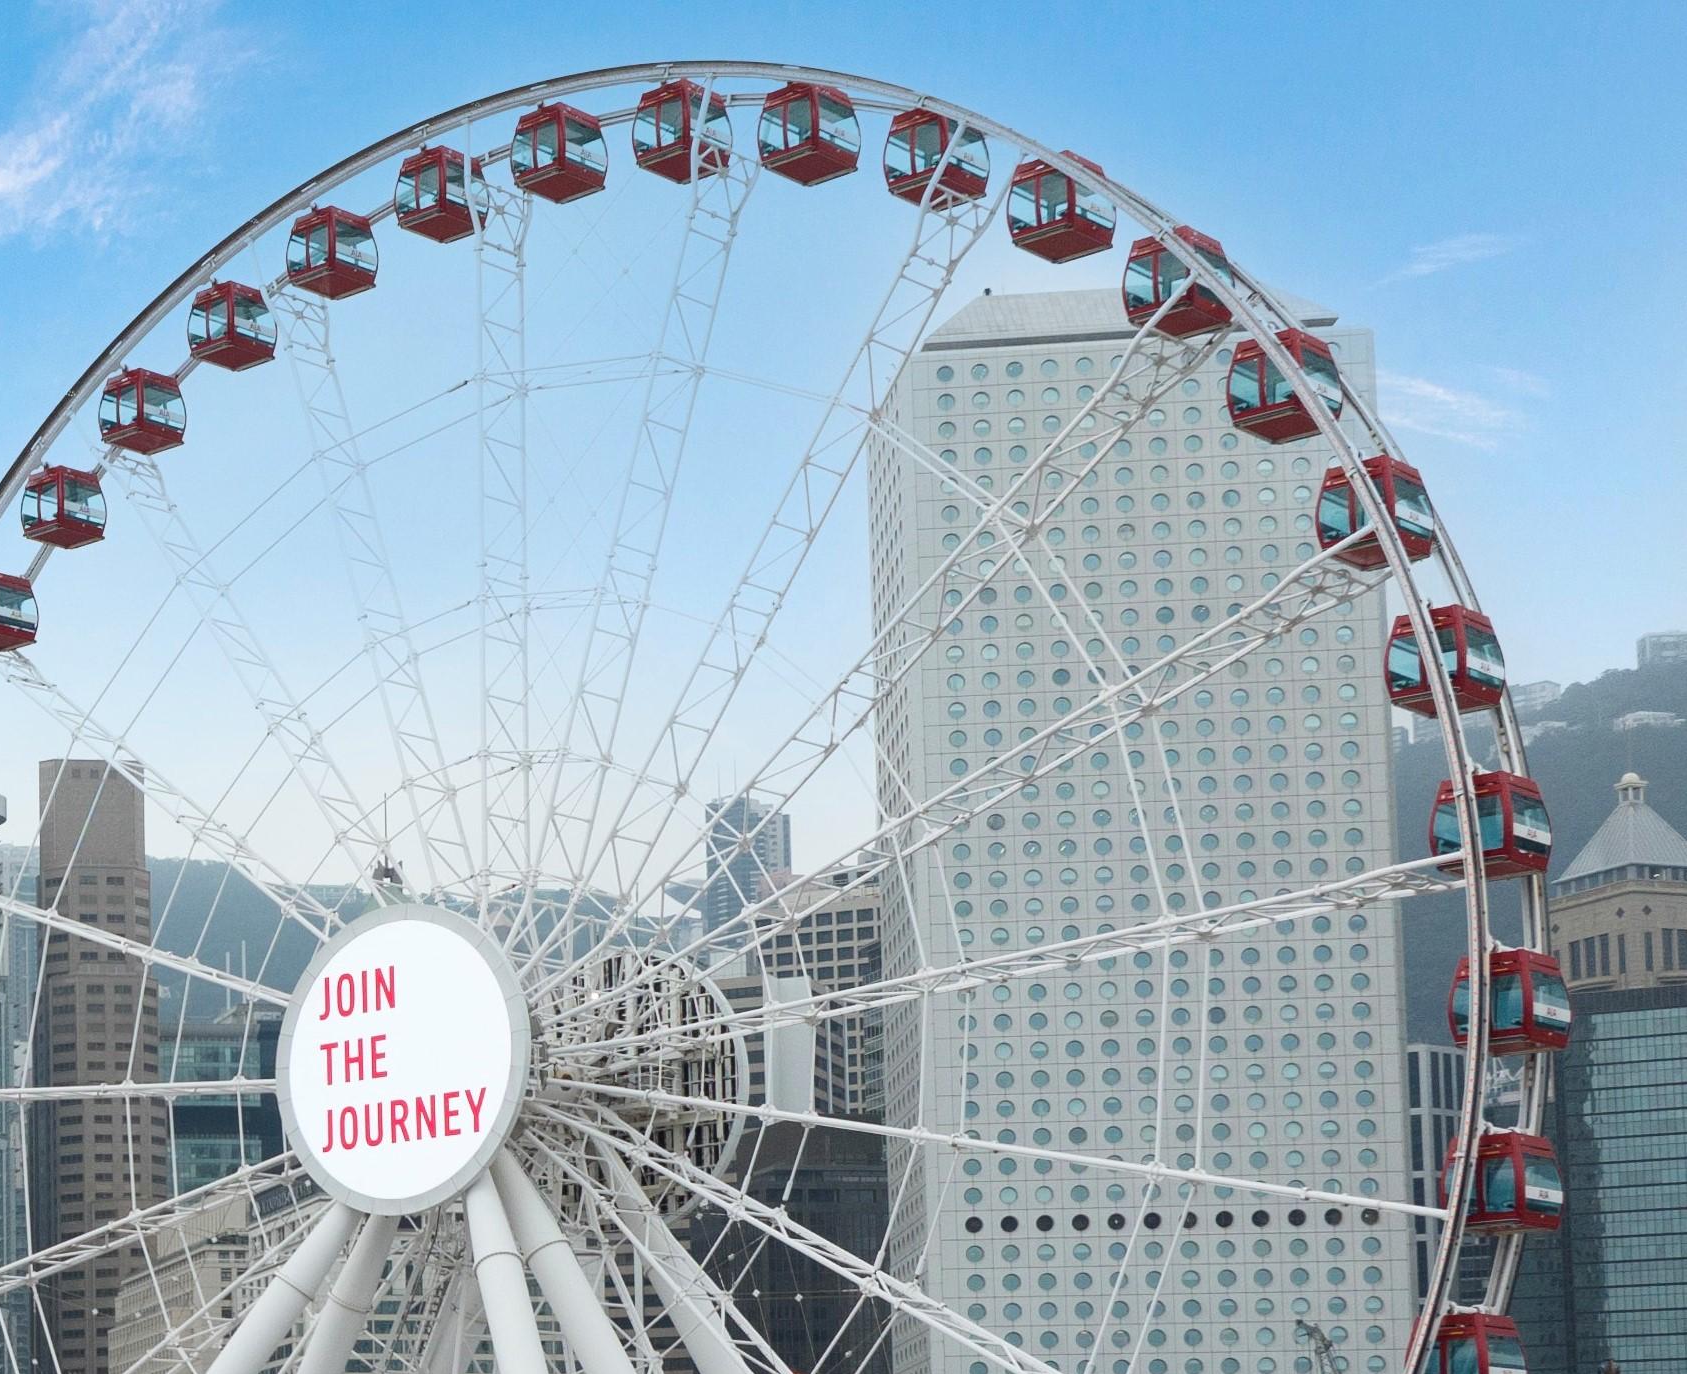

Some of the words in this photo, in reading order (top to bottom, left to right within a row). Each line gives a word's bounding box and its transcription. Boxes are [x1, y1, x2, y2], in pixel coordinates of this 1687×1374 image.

[319, 965, 396, 1021] JOIN
[320, 1034, 388, 1086] THE
[322, 1087, 487, 1153] JOURNEY
